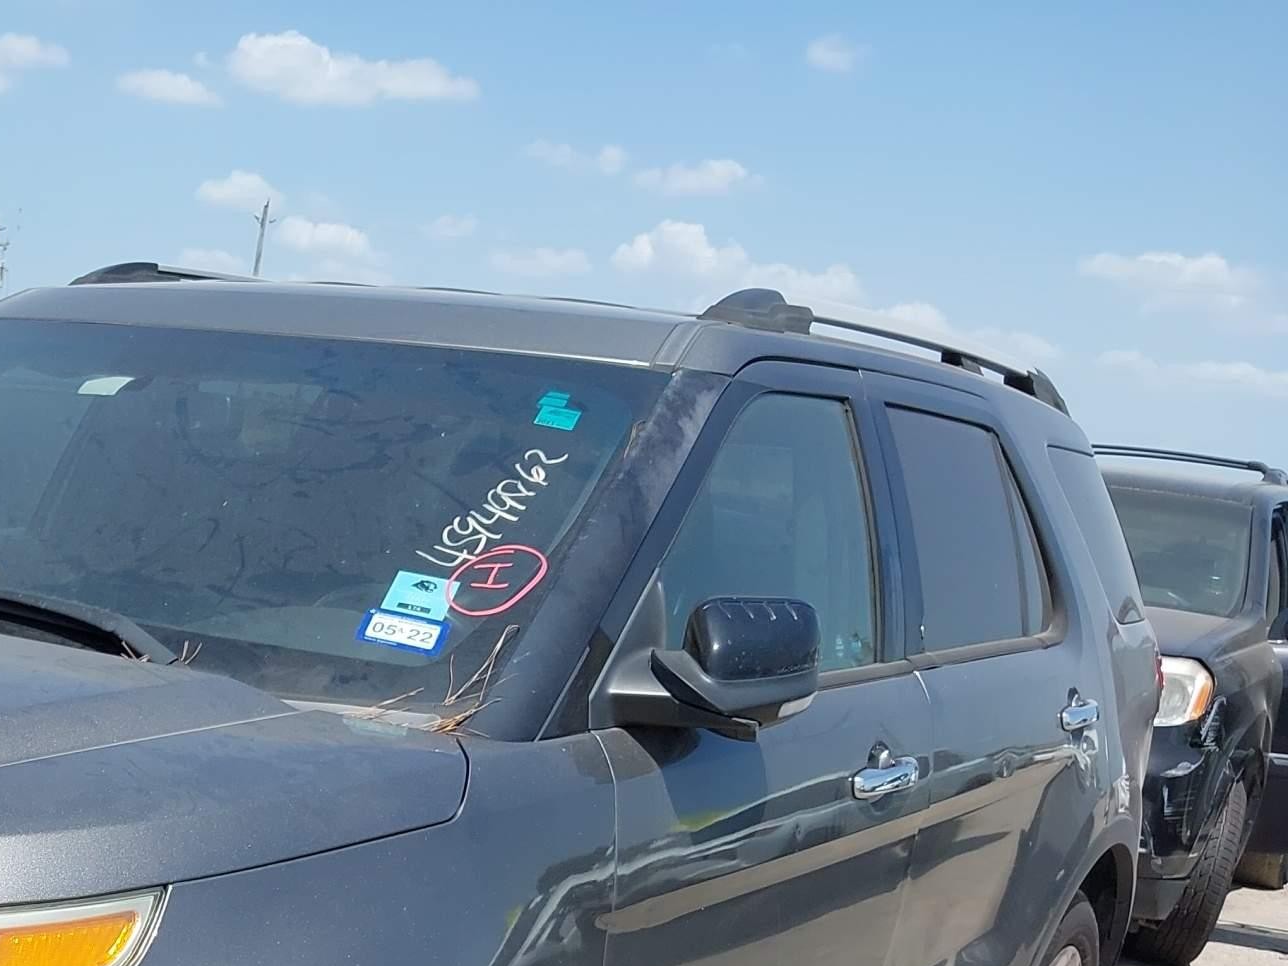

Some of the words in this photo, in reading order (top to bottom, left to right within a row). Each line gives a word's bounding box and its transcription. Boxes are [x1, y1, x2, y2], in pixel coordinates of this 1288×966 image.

[415, 448, 569, 567] 45949862
[372, 621, 398, 637] 05
[406, 628, 434, 645] 22
